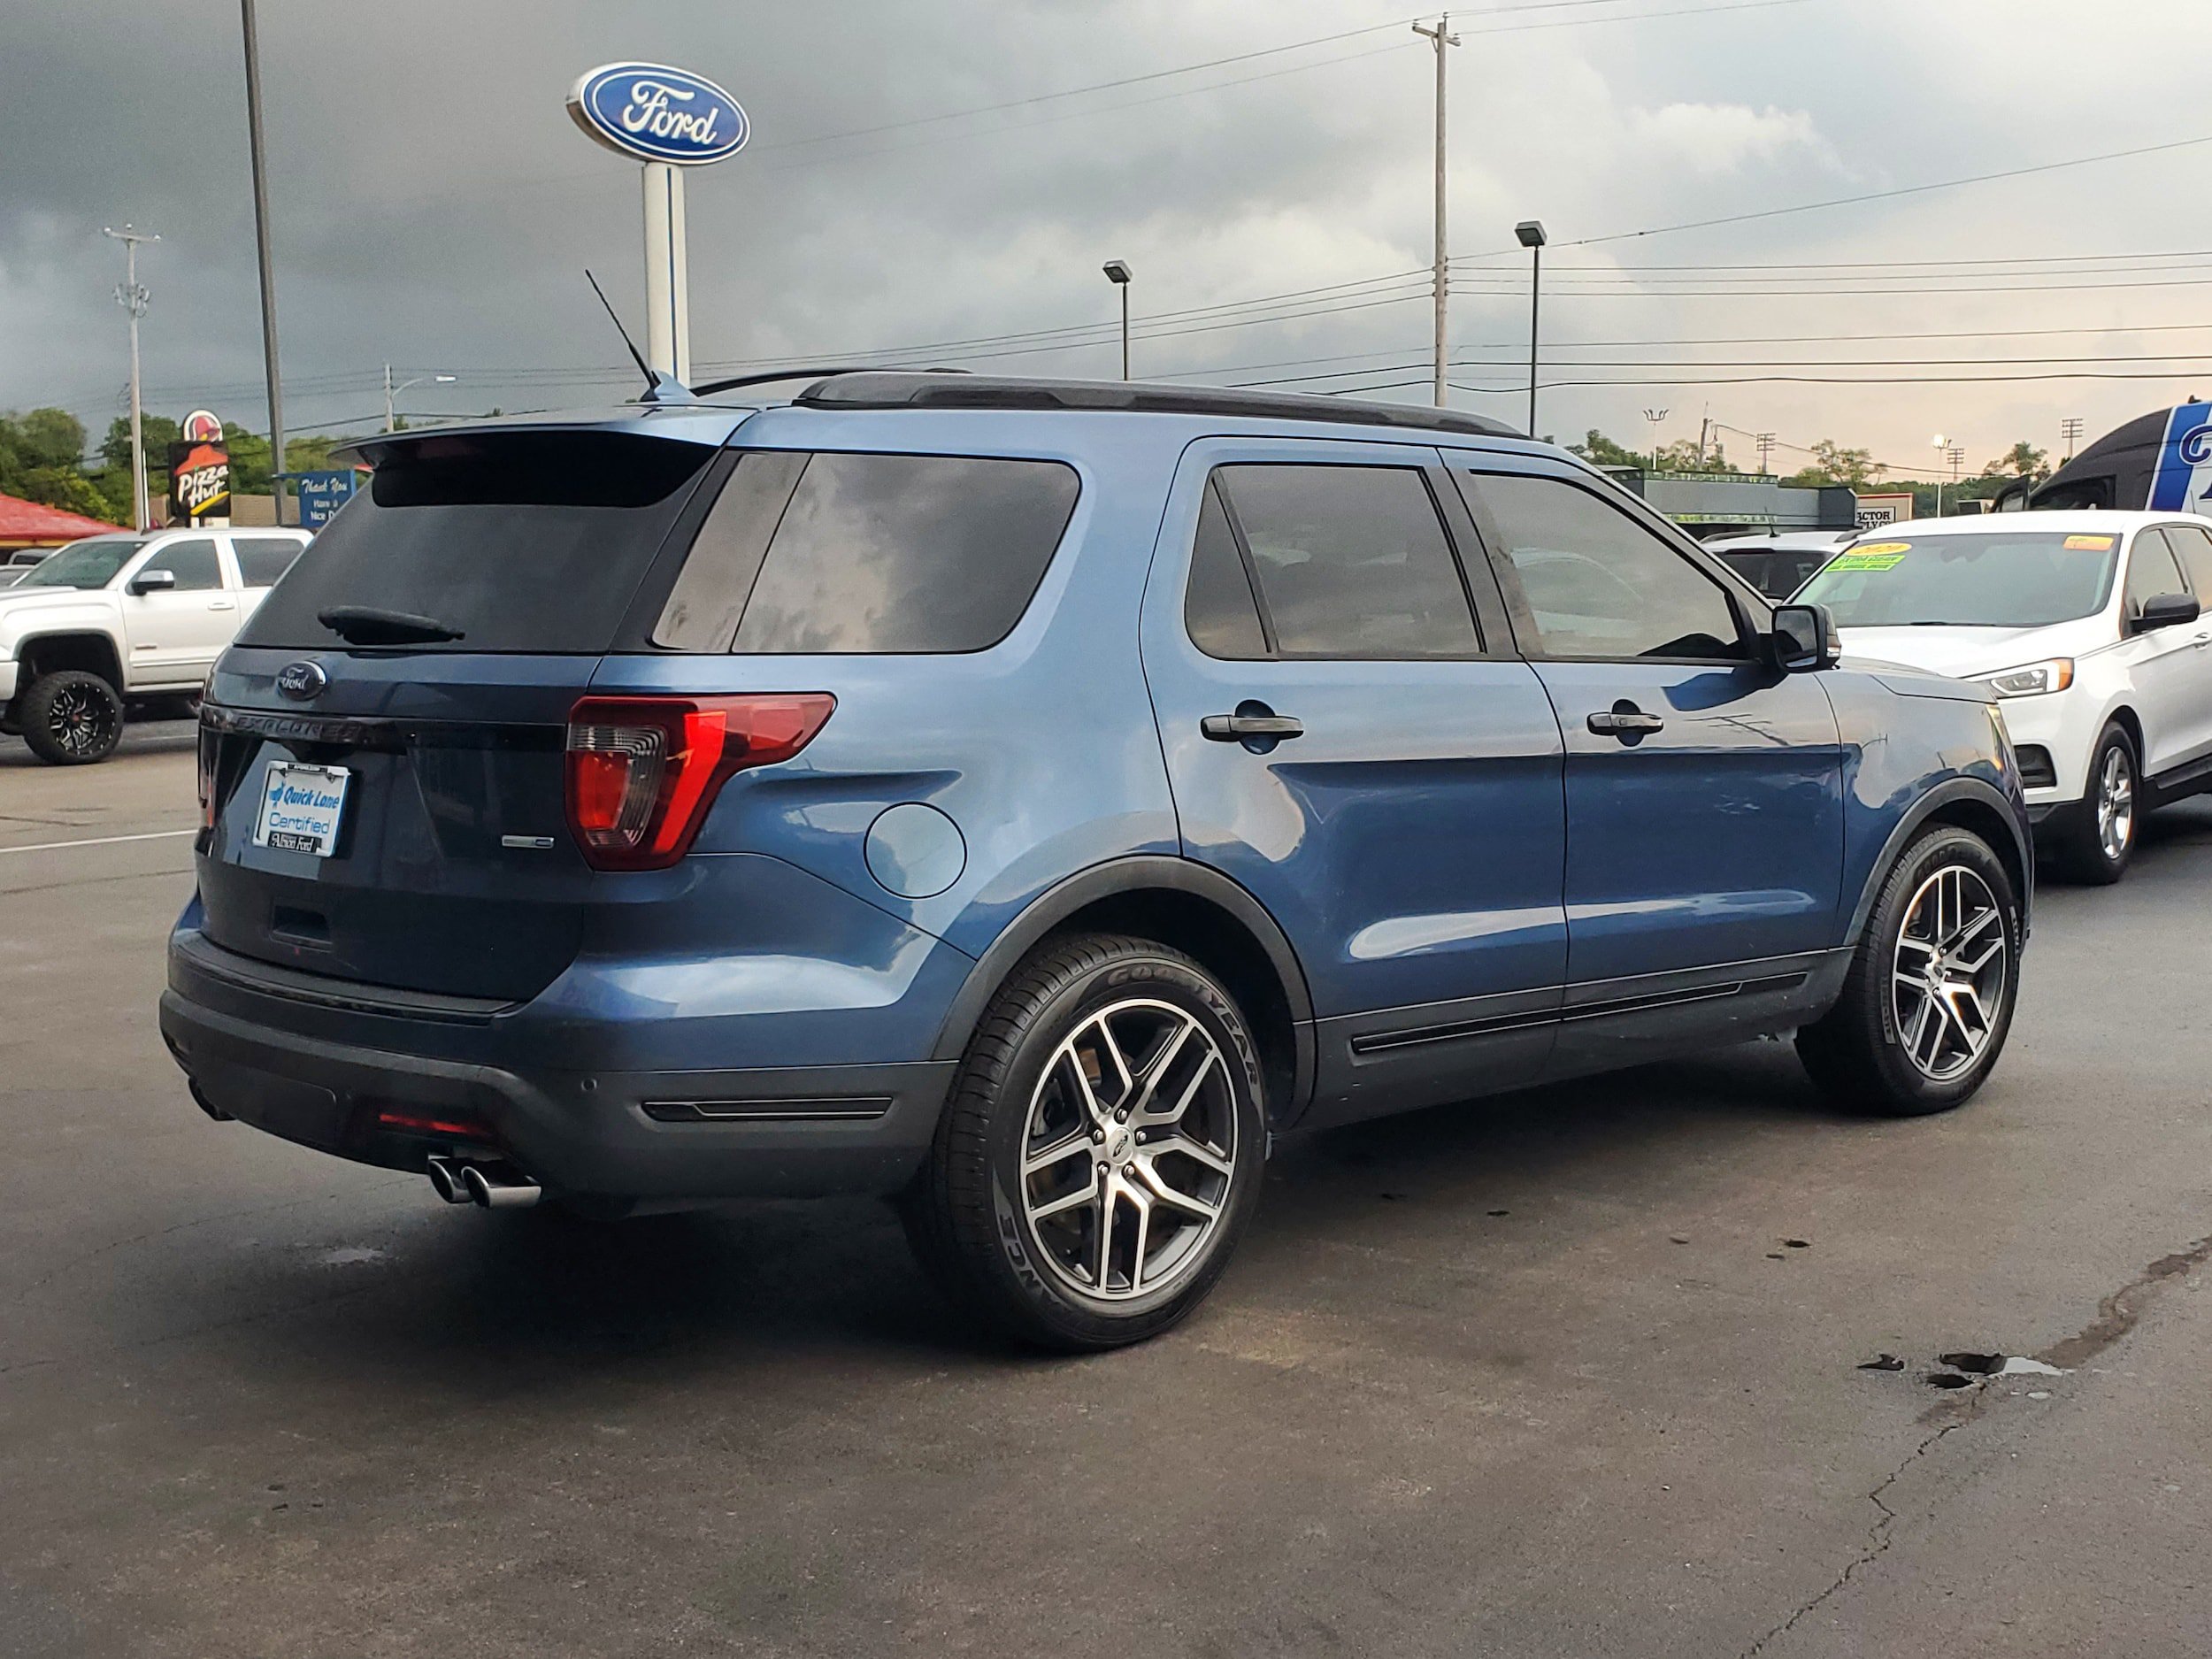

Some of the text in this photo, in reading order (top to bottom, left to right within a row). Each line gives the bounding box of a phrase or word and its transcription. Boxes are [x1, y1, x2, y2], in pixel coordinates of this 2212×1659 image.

[623, 81, 718, 145] Ford
[178, 465, 229, 503] Pizza
[188, 479, 226, 509] Hut
[302, 477, 348, 494] Thank You
[311, 511, 326, 520] Nice
[1857, 511, 1891, 520] ACTOR
[280, 666, 309, 690] Ford
[283, 786, 340, 809] Quick Lane
[269, 811, 330, 834] Certified
